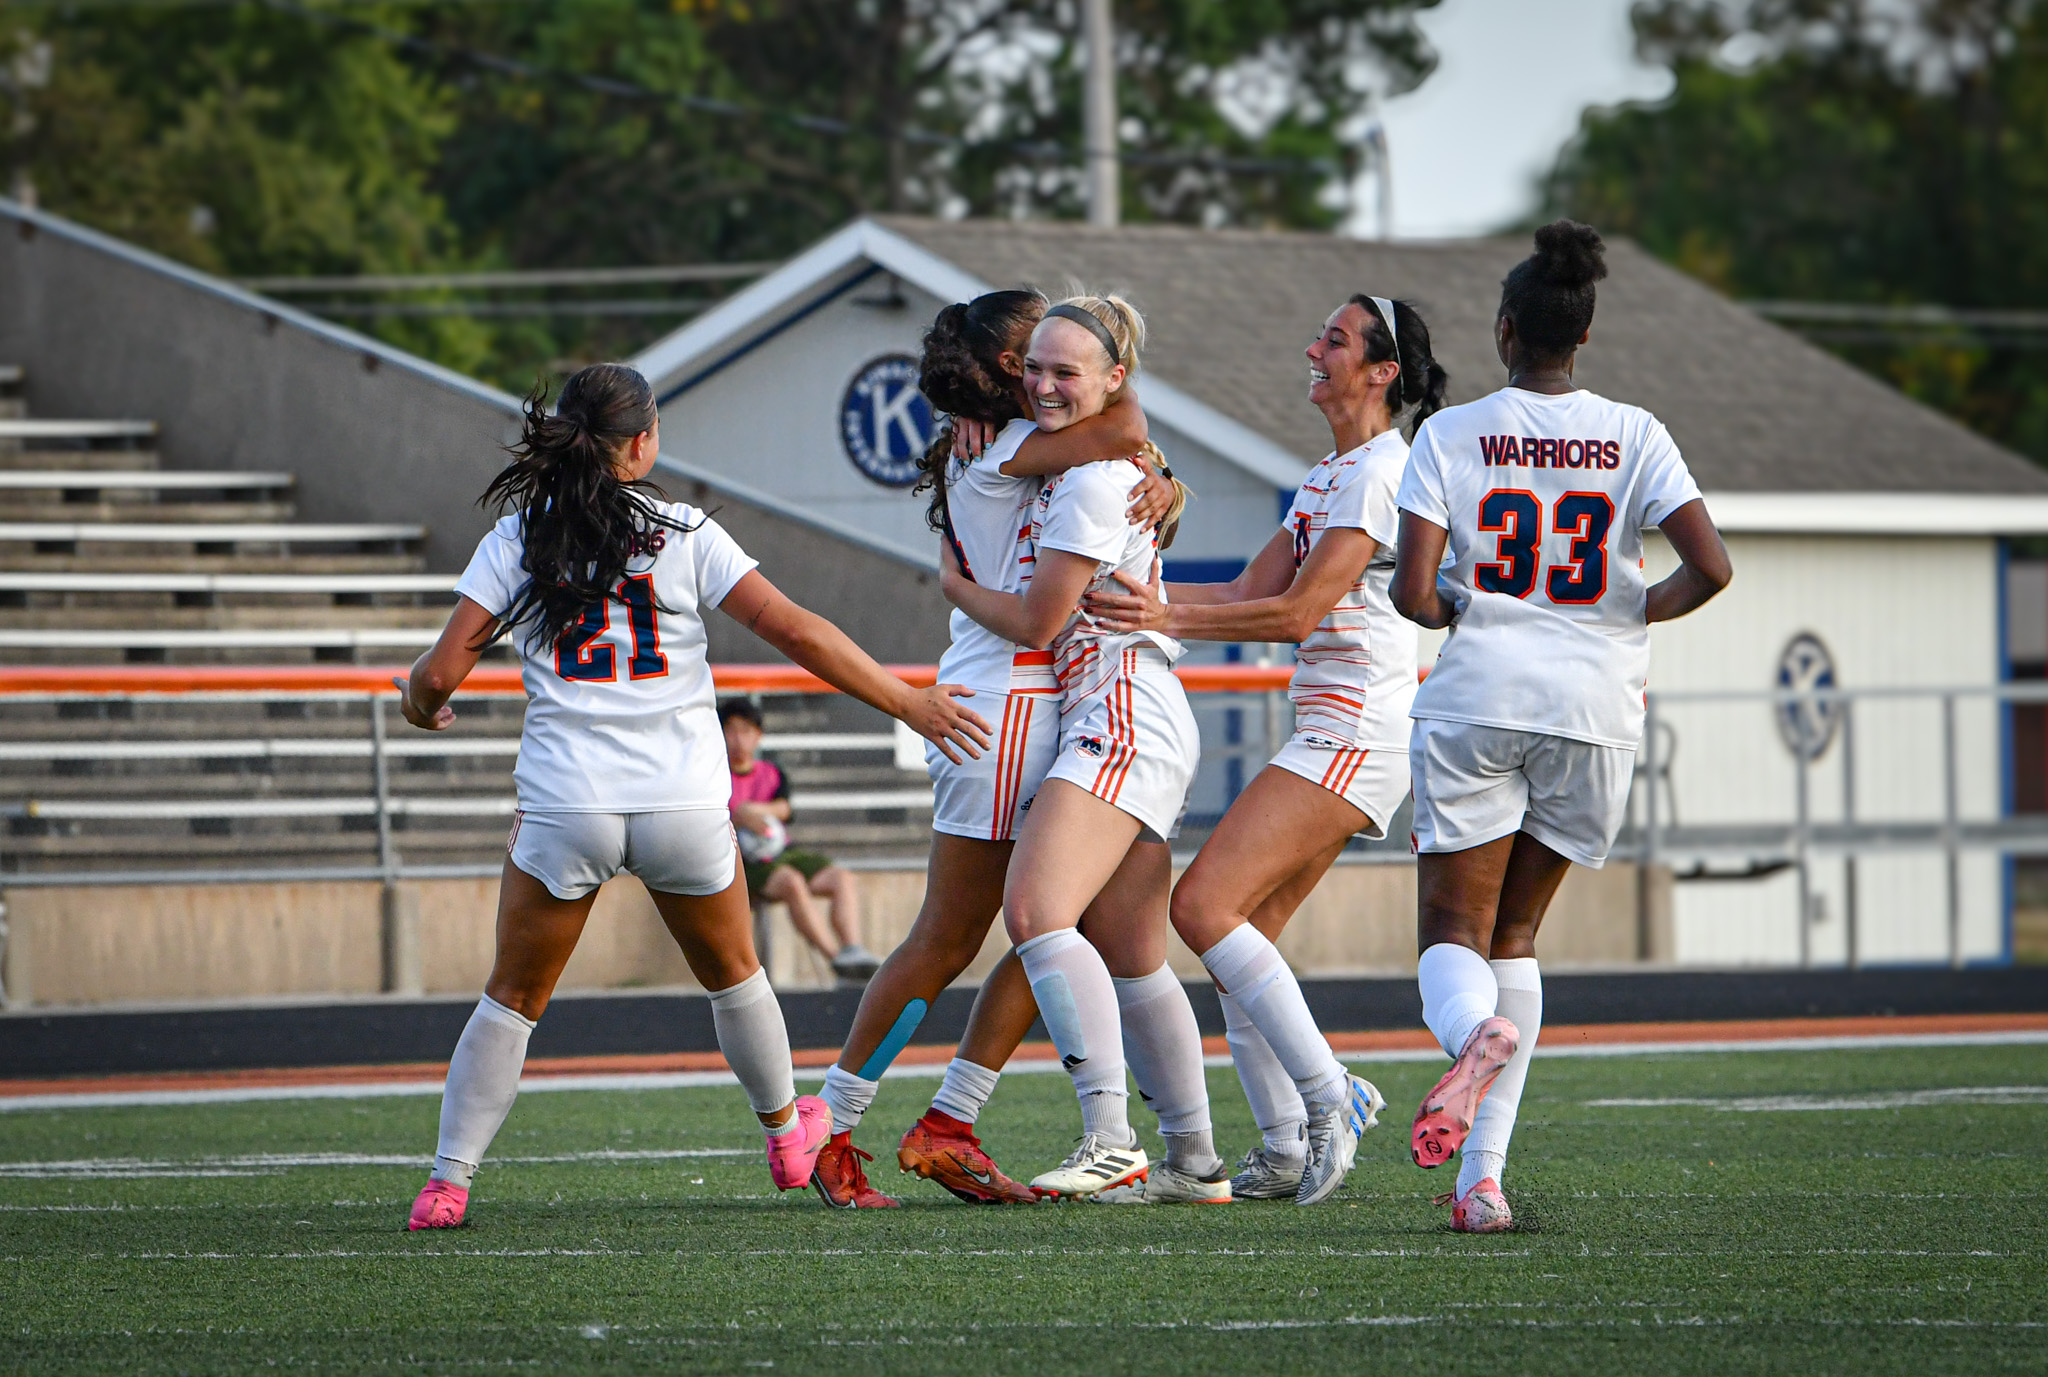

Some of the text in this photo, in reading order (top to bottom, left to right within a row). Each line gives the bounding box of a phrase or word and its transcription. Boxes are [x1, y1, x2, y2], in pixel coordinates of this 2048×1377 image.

[872, 384, 925, 460] K
[1479, 435, 1620, 470] WARRIORS
[1474, 488, 1616, 605] 33
[554, 573, 669, 682] 21
